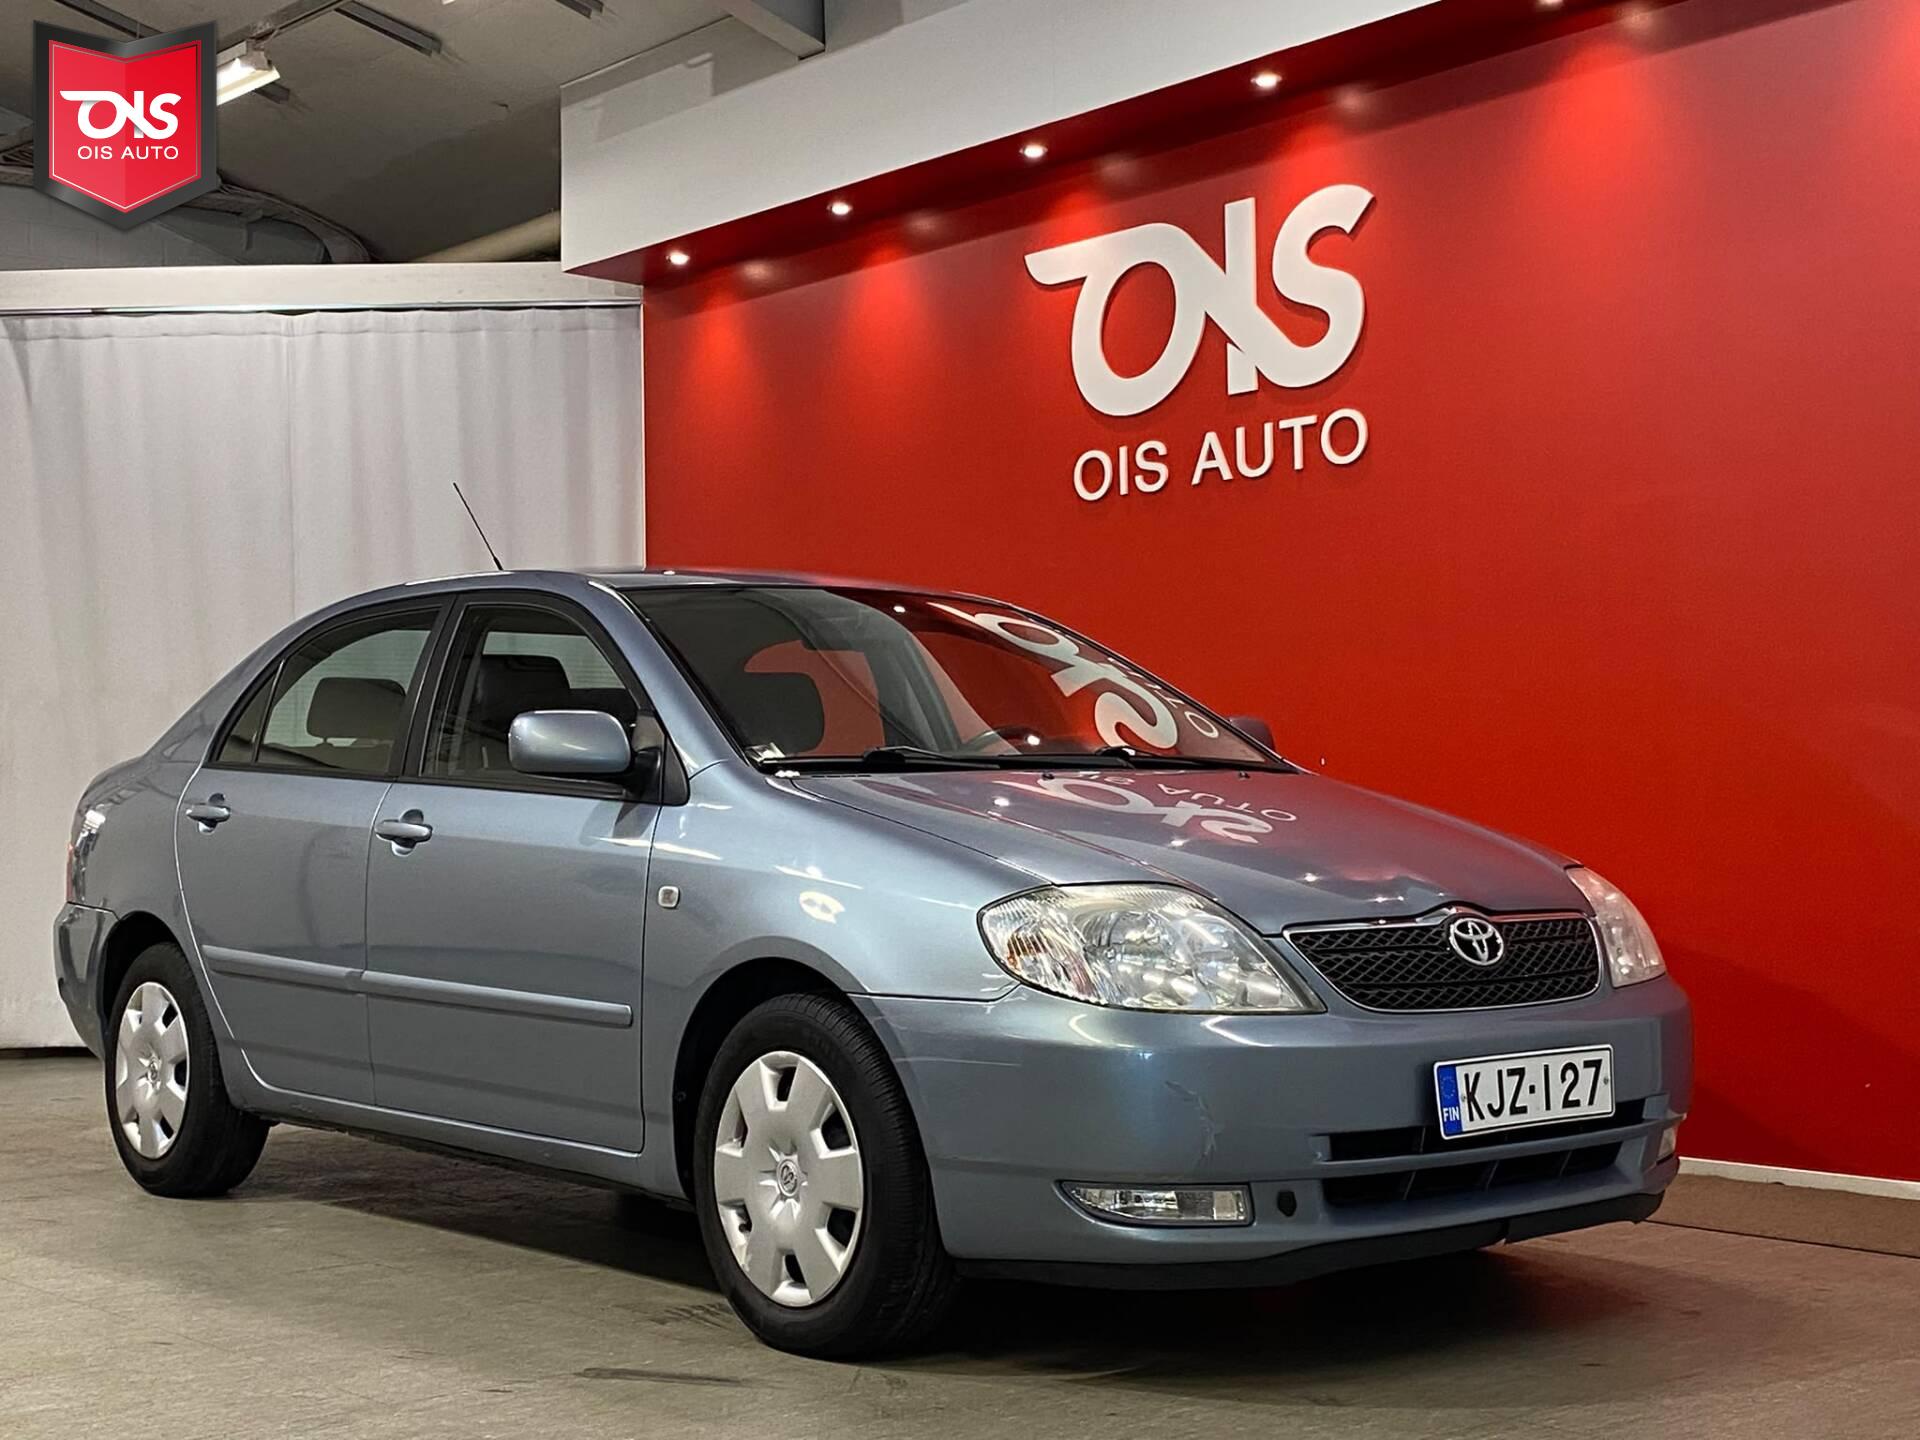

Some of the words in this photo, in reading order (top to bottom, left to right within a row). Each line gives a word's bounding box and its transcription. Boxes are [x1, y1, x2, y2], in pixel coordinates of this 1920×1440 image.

[1024, 183, 1375, 417] OIS
[1073, 440, 1169, 501] OIS
[1191, 408, 1369, 485] AUTO
[1443, 1107, 1460, 1123] FIN
[1464, 1058, 1603, 1123] KJZ-127
